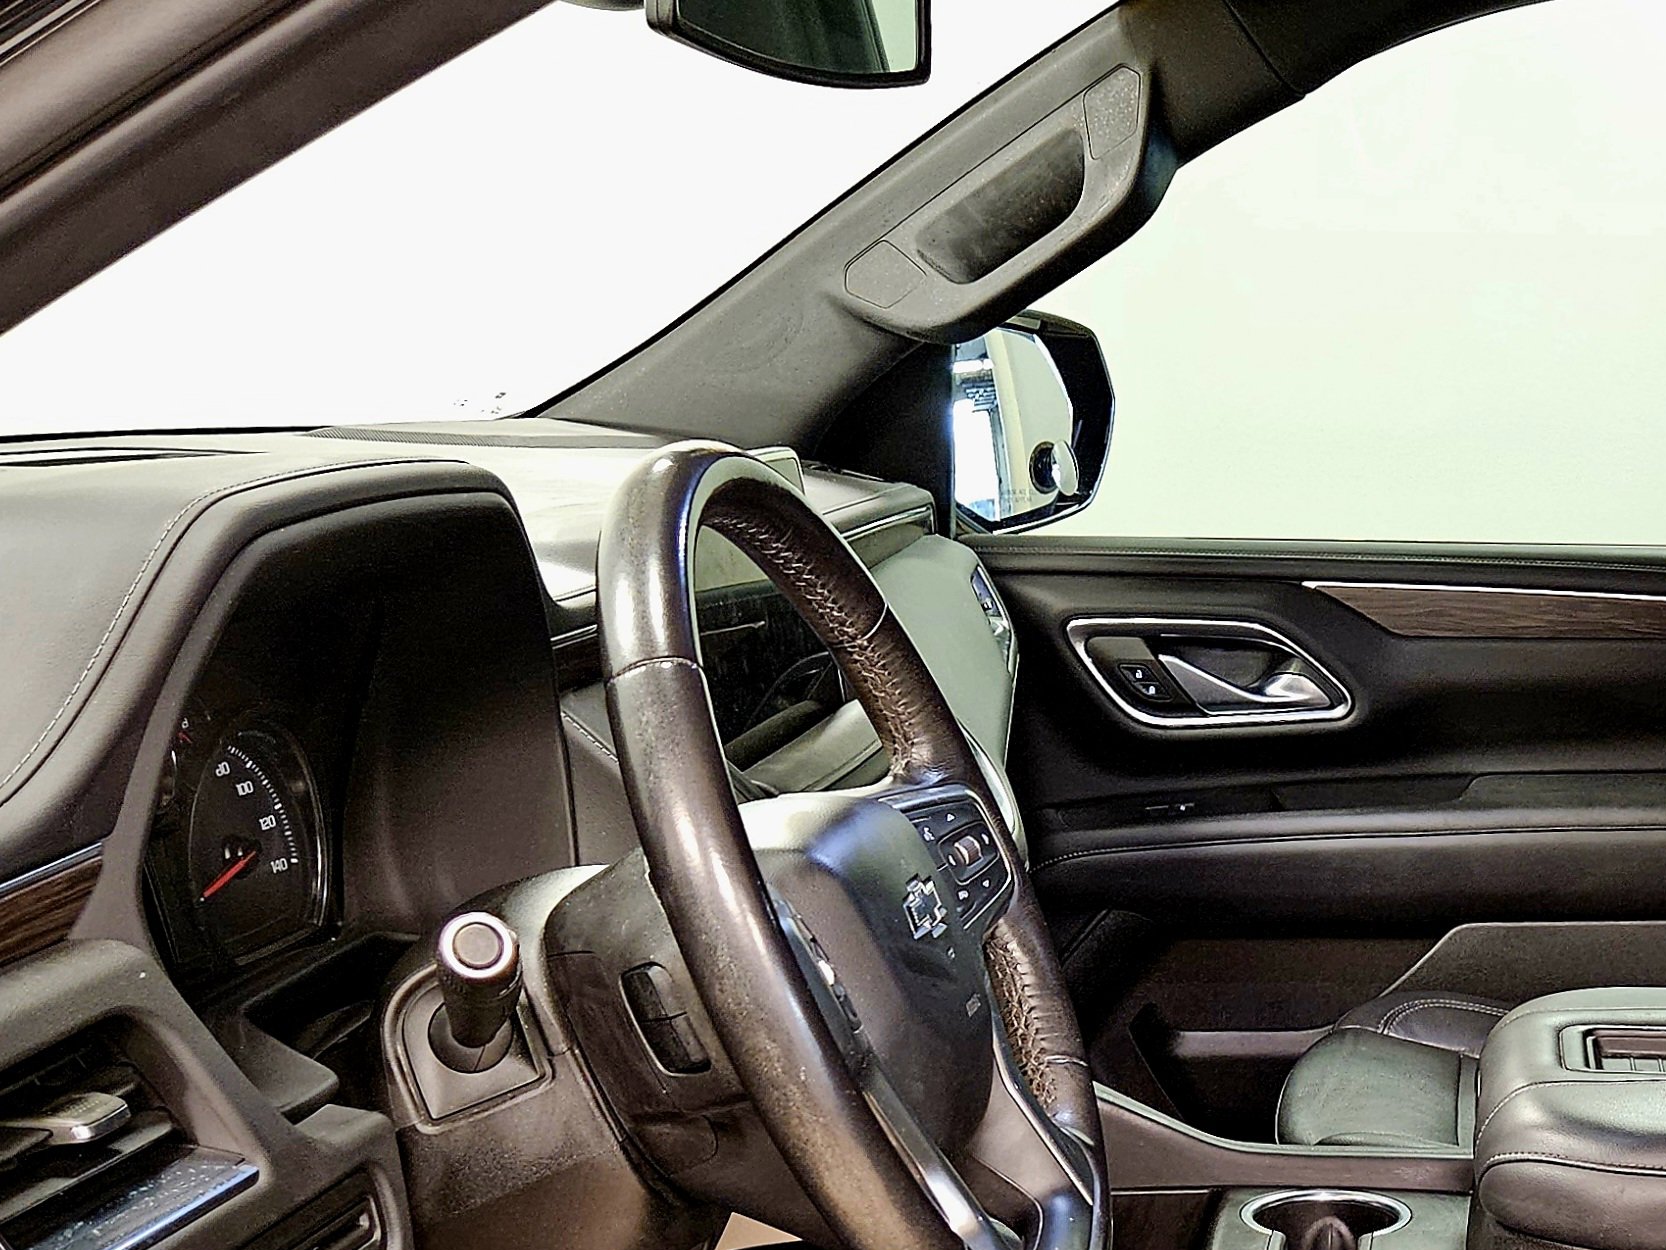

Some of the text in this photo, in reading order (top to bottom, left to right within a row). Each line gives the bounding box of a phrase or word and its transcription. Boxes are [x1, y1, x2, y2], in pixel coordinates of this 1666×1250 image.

[235, 780, 254, 796] 100
[259, 815, 276, 831] 120
[270, 857, 289, 874] 140
